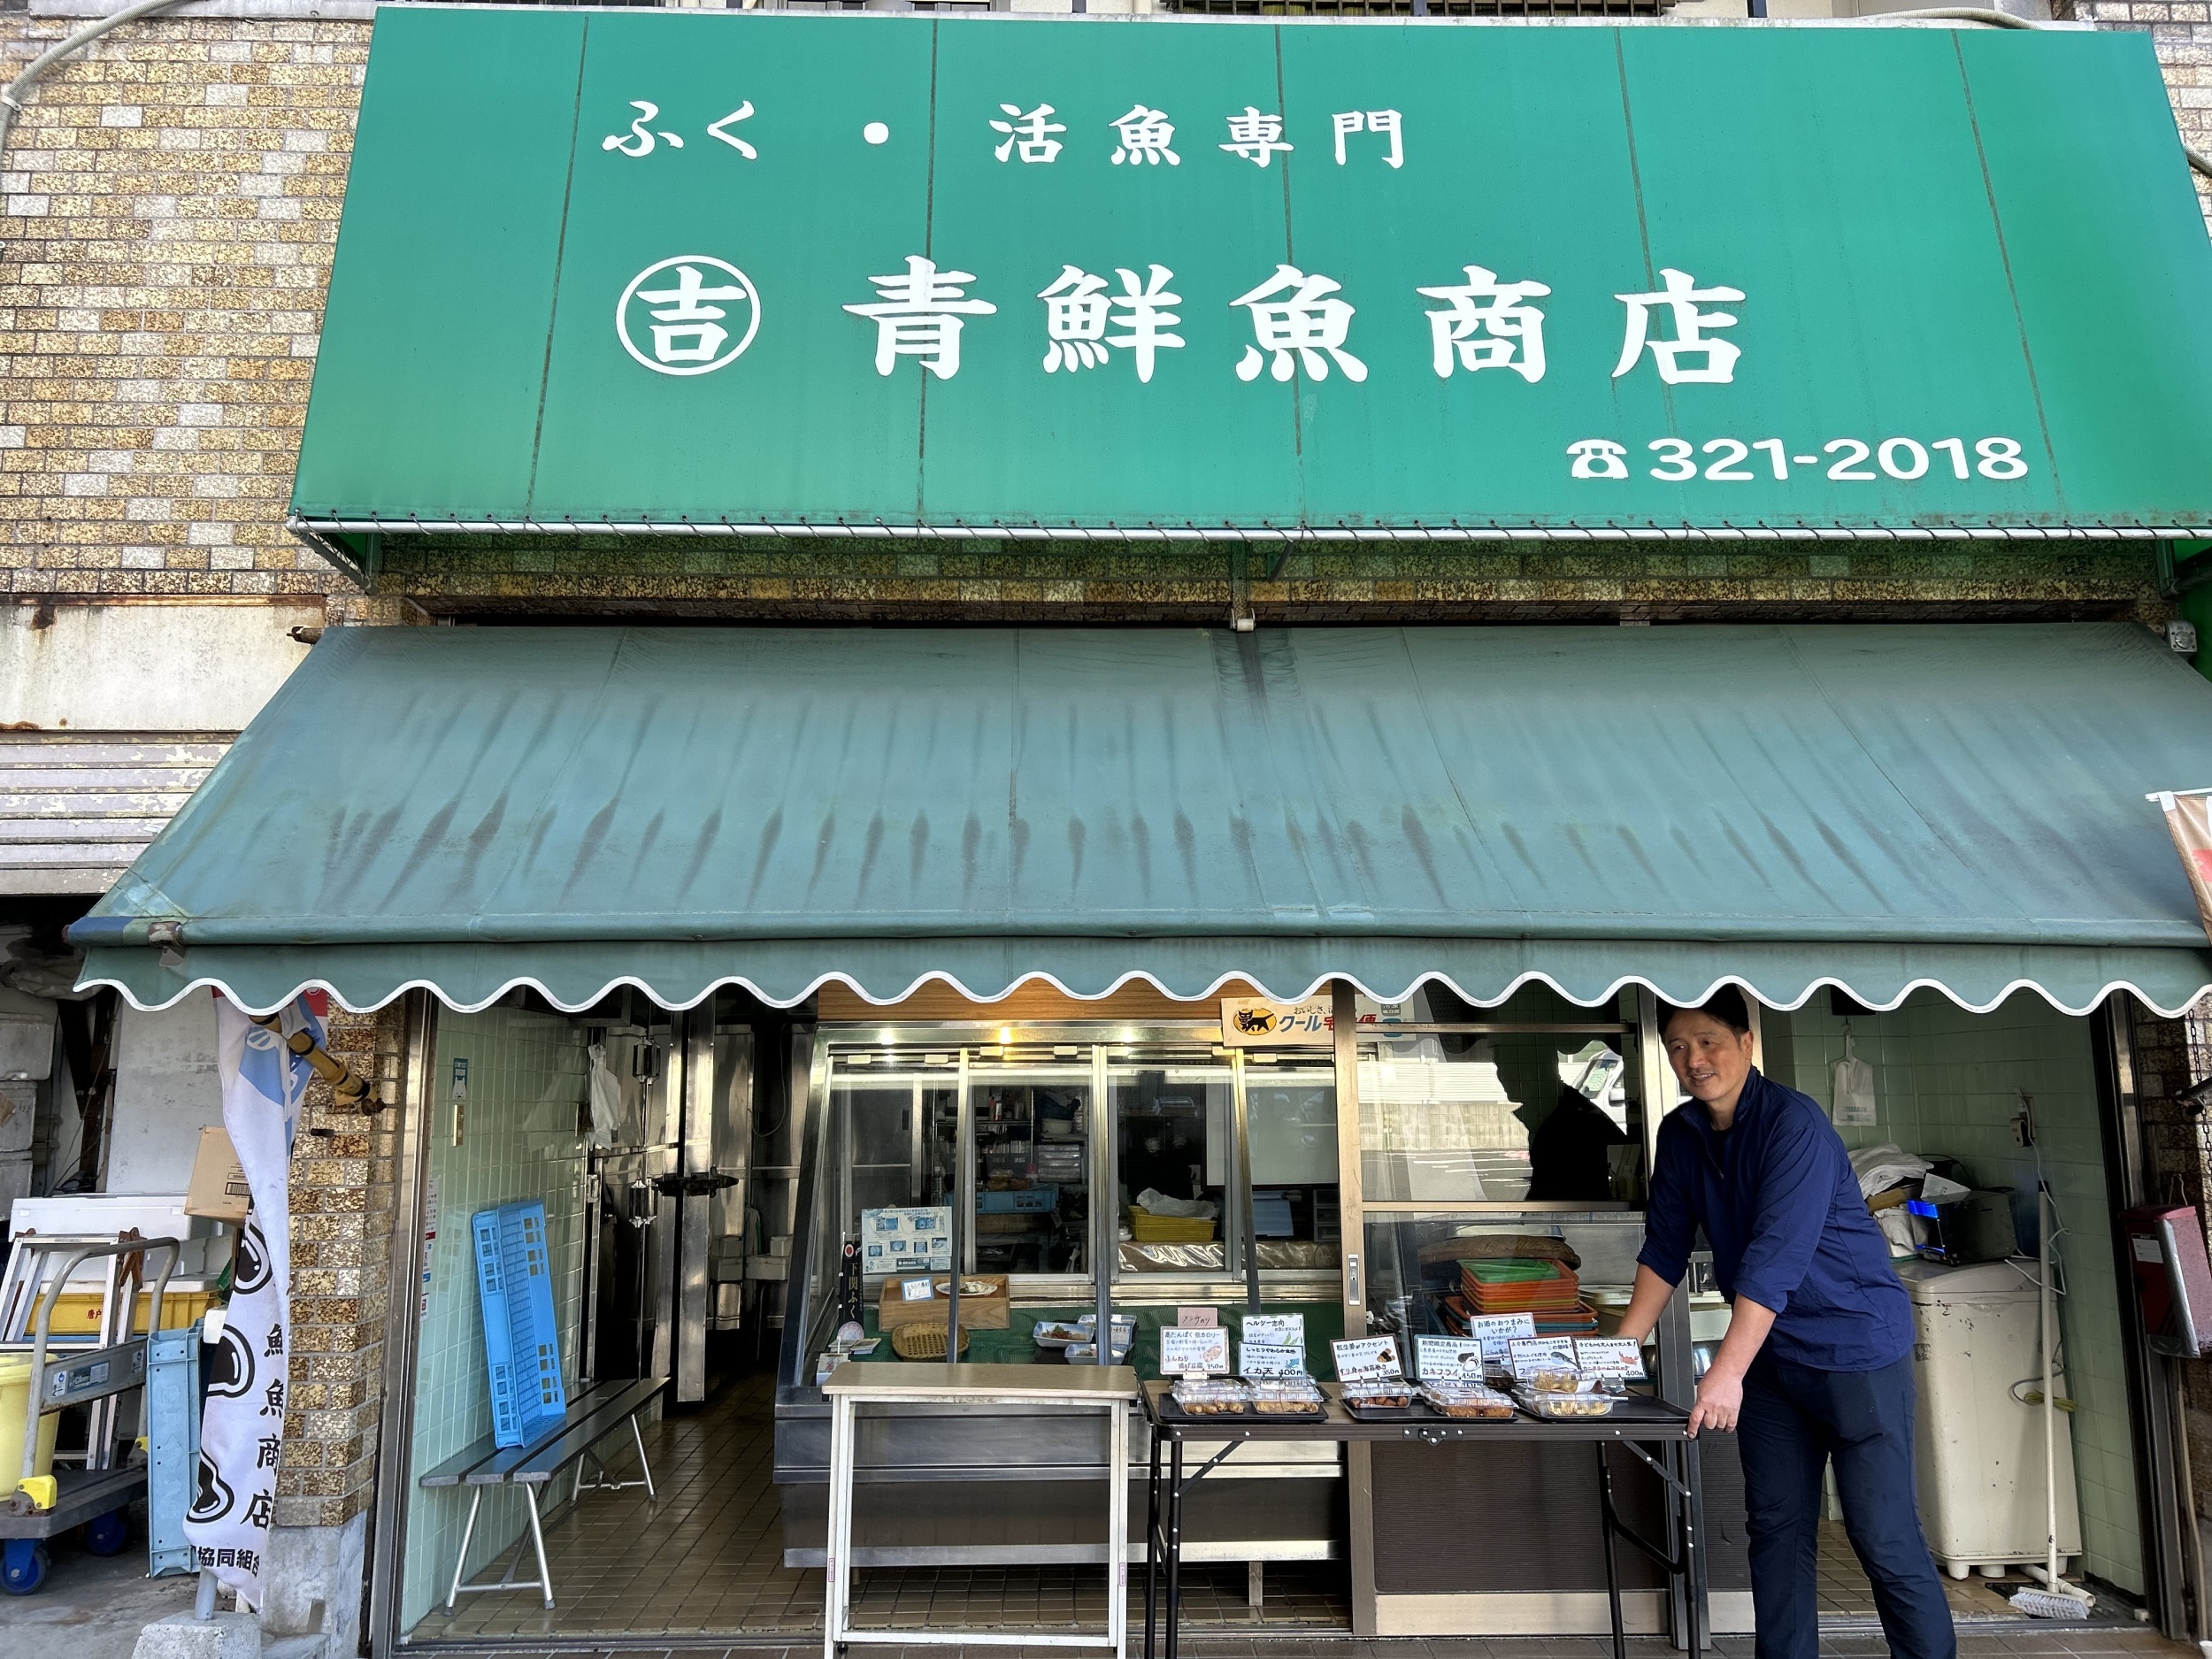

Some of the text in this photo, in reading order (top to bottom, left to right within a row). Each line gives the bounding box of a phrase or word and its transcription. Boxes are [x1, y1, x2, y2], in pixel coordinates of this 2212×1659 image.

[841, 254, 1747, 385] 青鮮魚商店
[1647, 437, 2029, 481] 321-2018
[1294, 1006, 1333, 1015] おいしさ、
[848, 1262, 858, 1319] 下関ふく
[1243, 1366, 1274, 1375] イカ天
[1422, 1367, 1459, 1377] カキフライ
[190, 1544, 260, 1578] 協同組合
